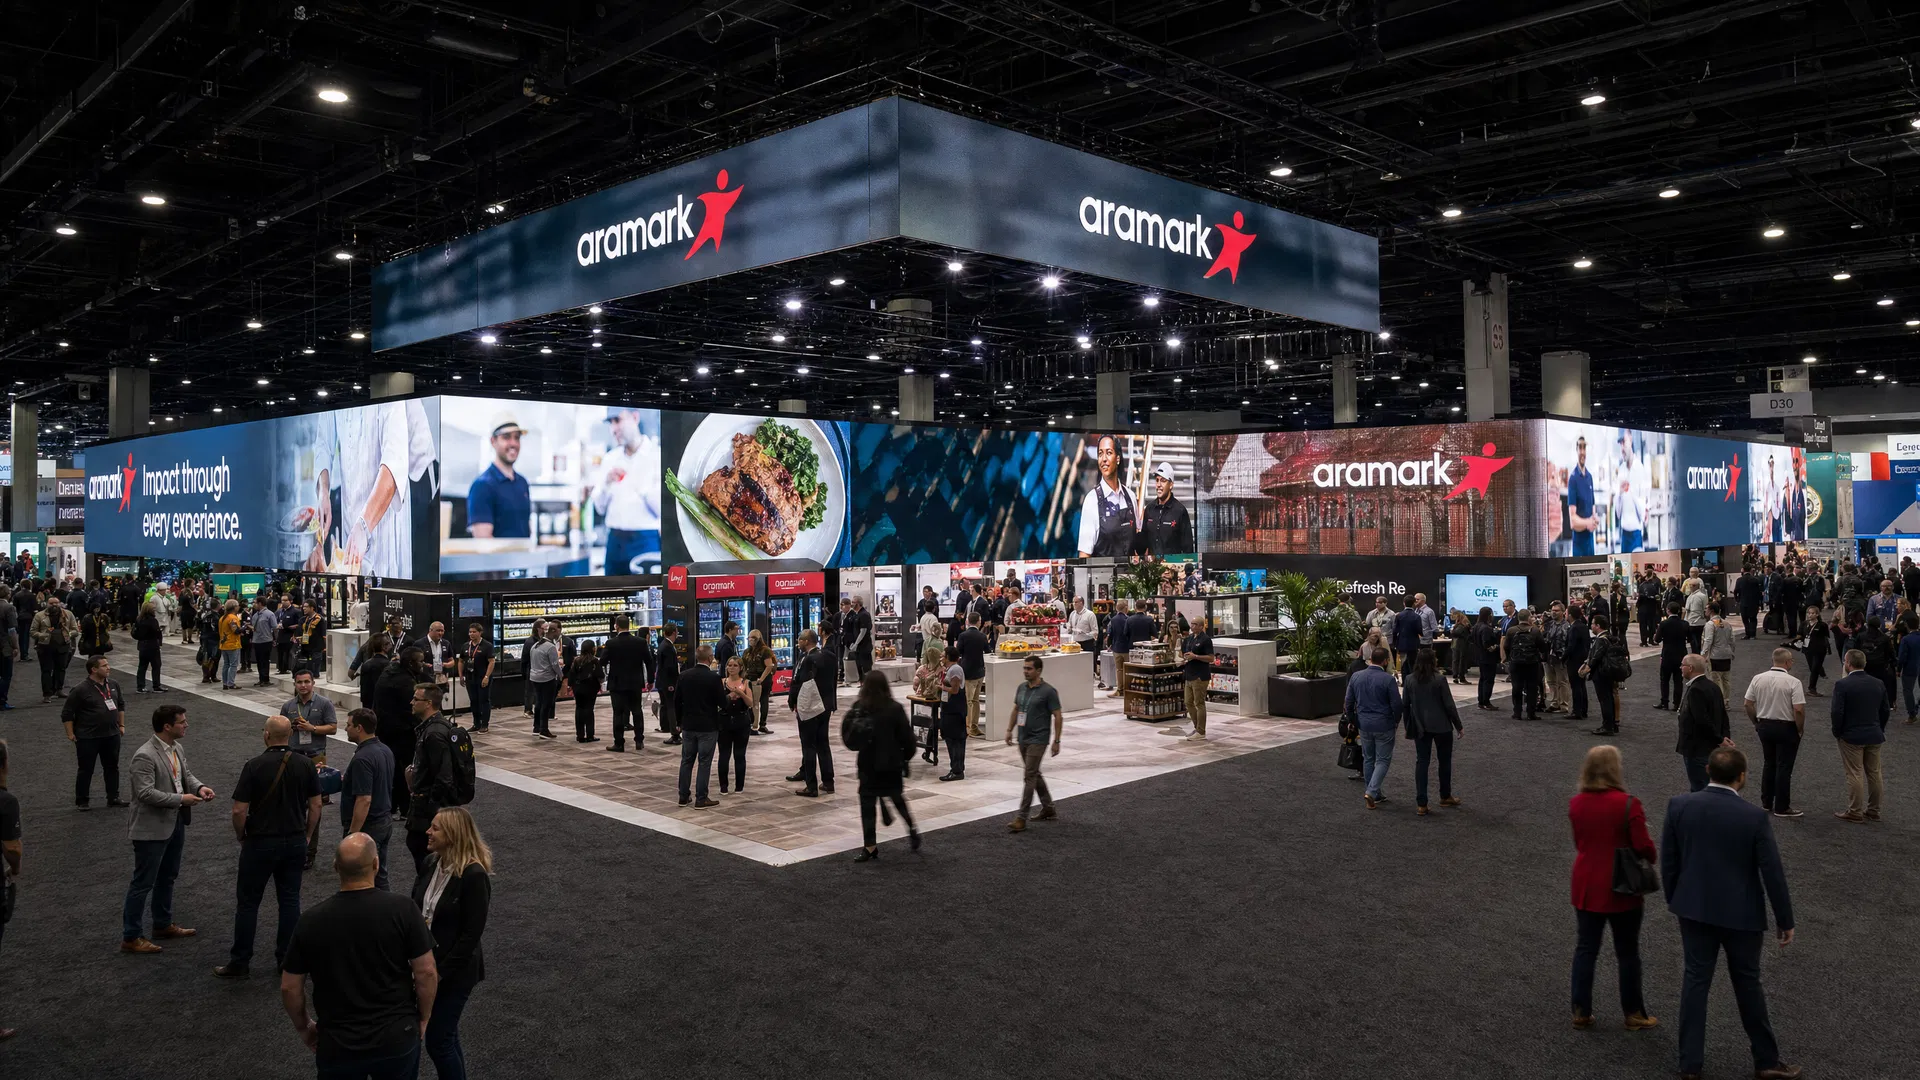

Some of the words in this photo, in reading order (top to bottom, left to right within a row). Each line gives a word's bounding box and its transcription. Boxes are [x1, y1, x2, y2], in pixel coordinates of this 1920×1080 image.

[577, 194, 694, 267] aramark
[1079, 196, 1213, 260] aramark
[1770, 399, 1794, 410] D30
[89, 465, 122, 500] aramark
[143, 464, 180, 503] Impact
[182, 456, 230, 502] through
[1313, 452, 1454, 488] aramark
[1687, 461, 1728, 490] aramark
[143, 512, 170, 546] every
[173, 504, 242, 547] experience.
[1336, 581, 1385, 595] Refresh
[1389, 581, 1406, 595] Re
[1475, 588, 1499, 598] CAFE
